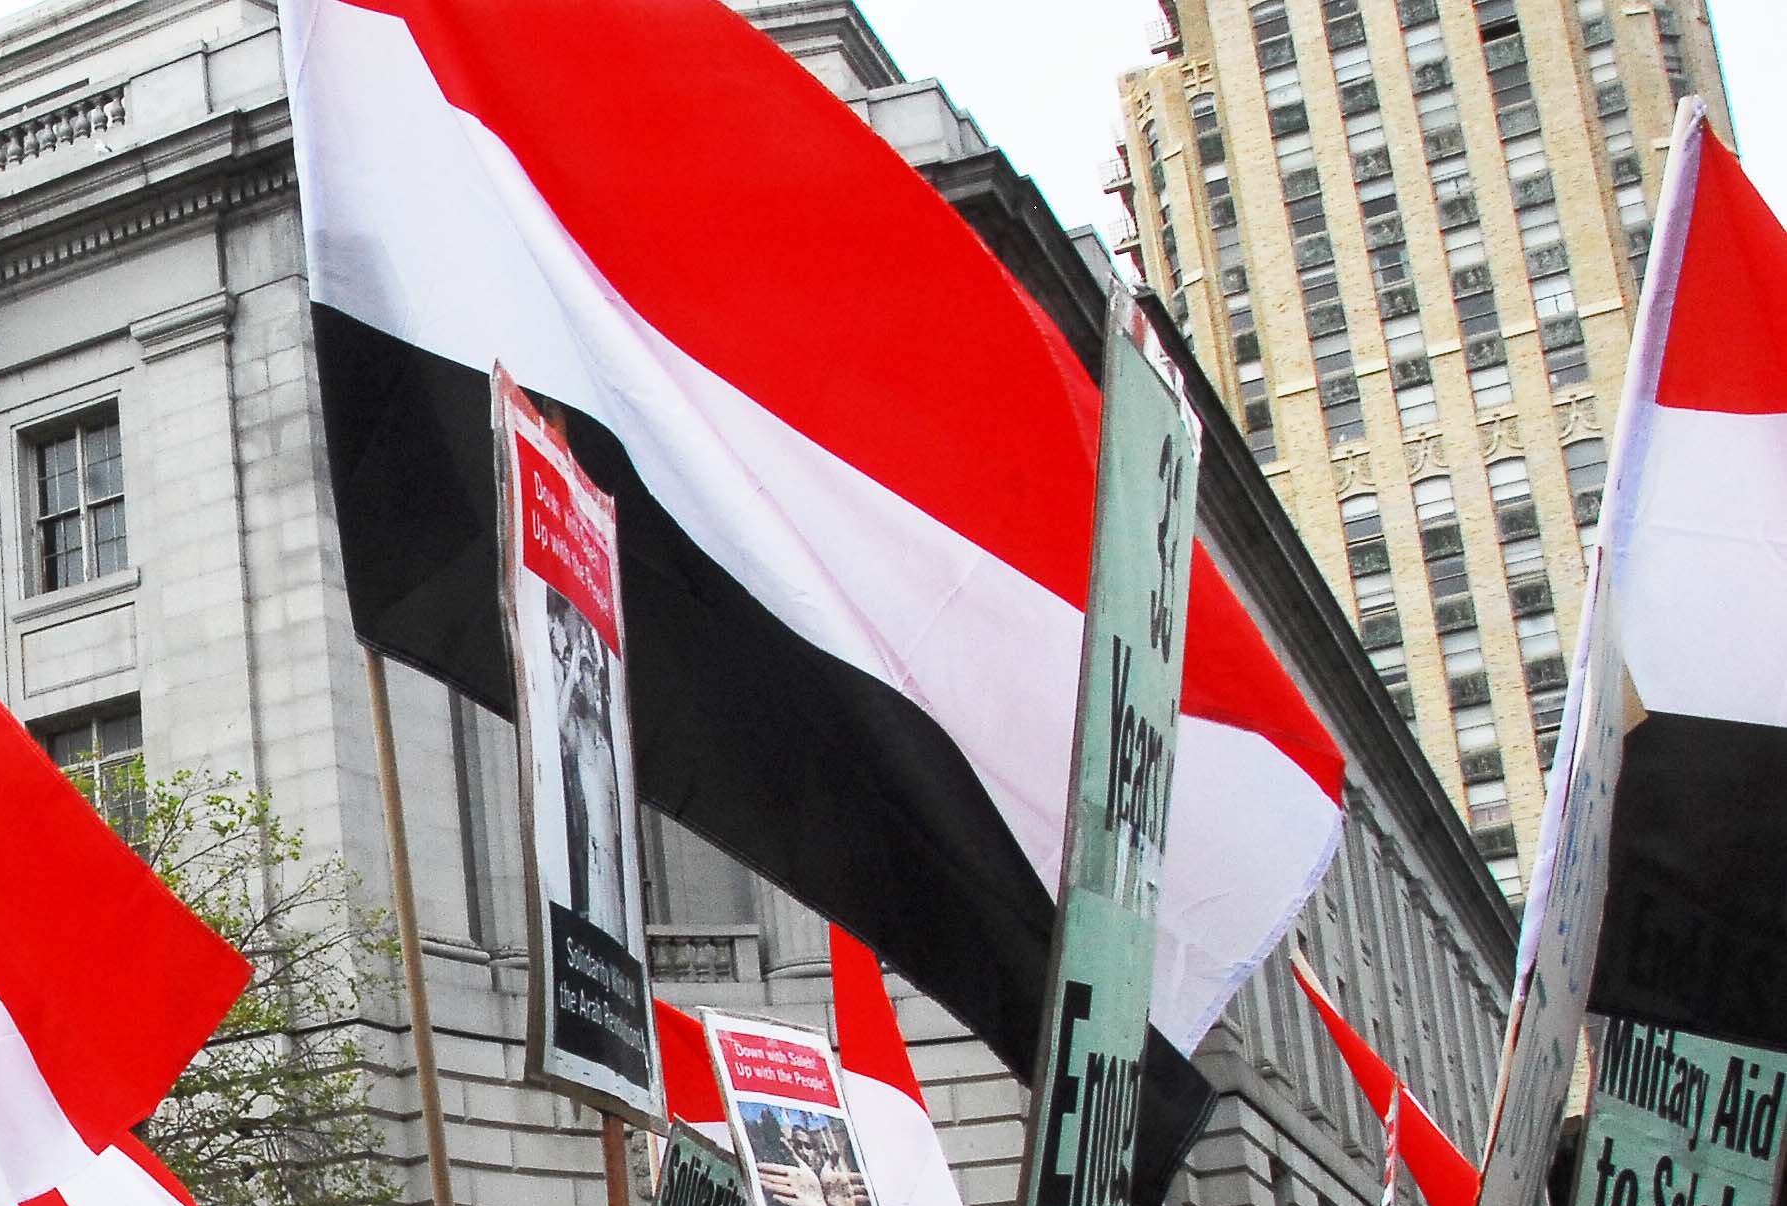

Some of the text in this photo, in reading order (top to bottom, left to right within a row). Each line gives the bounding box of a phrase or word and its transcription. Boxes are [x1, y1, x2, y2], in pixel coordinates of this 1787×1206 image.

[531, 509, 548, 549] Up
[734, 1042, 765, 1059] Down
[765, 1049, 788, 1063] with
[735, 1062, 752, 1079] Up
[753, 1065, 776, 1080] with
[777, 1068, 793, 1084] the
[1598, 1016, 1710, 1152] Military
[1711, 1056, 1785, 1161] Aid
